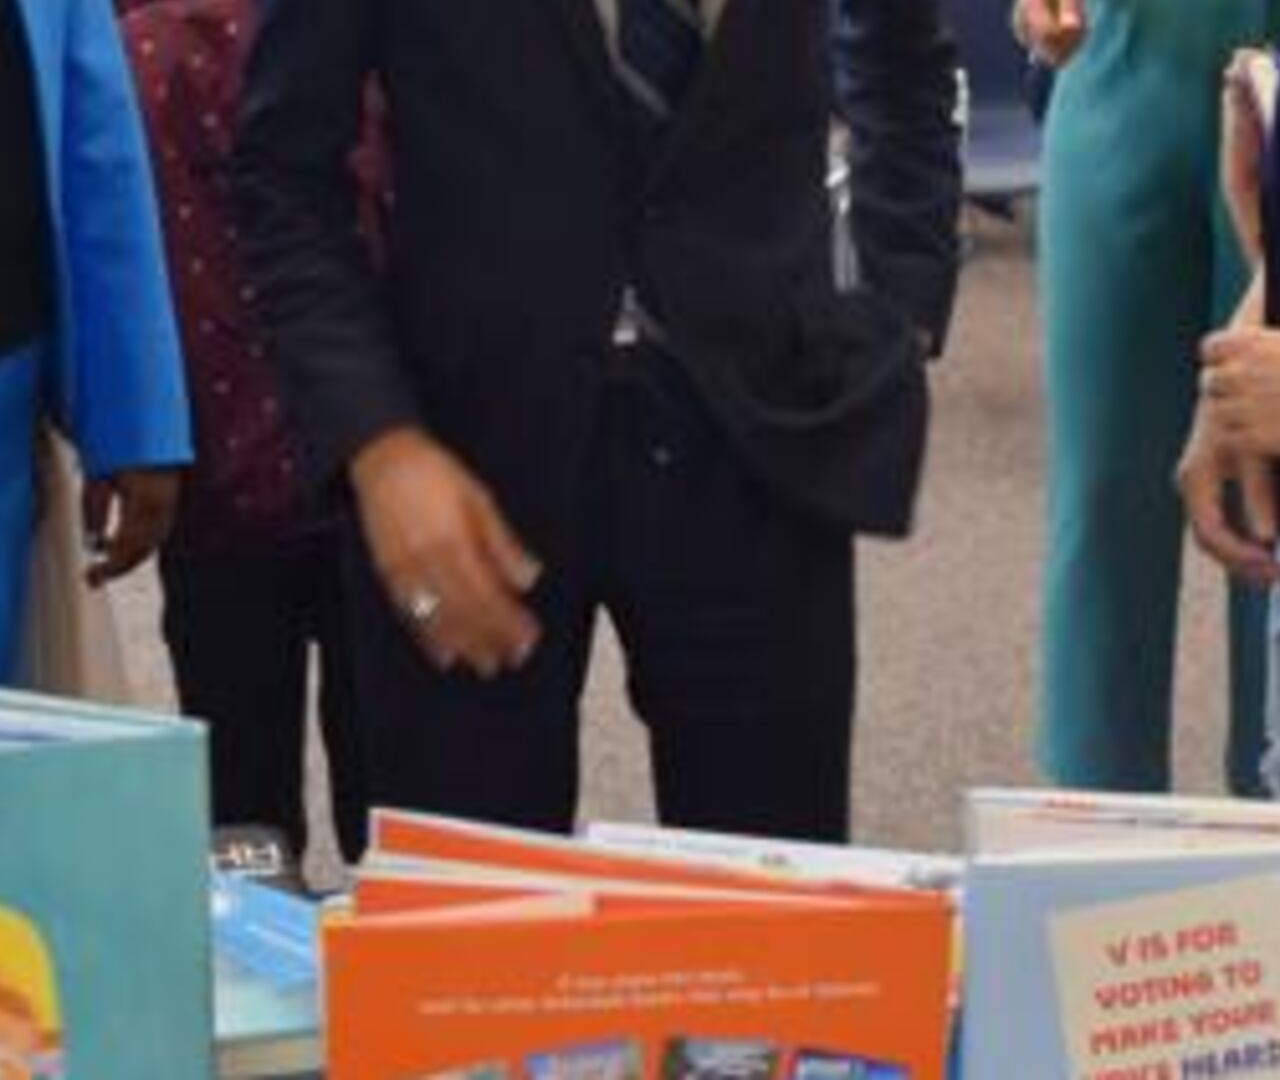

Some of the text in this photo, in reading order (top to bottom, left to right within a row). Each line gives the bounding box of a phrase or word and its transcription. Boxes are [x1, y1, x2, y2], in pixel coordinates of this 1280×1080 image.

[1105, 920, 1238, 967] V IS FOR
[1095, 959, 1262, 1009] VOTING TO
[1090, 998, 1277, 1055] MAKE YOUR
